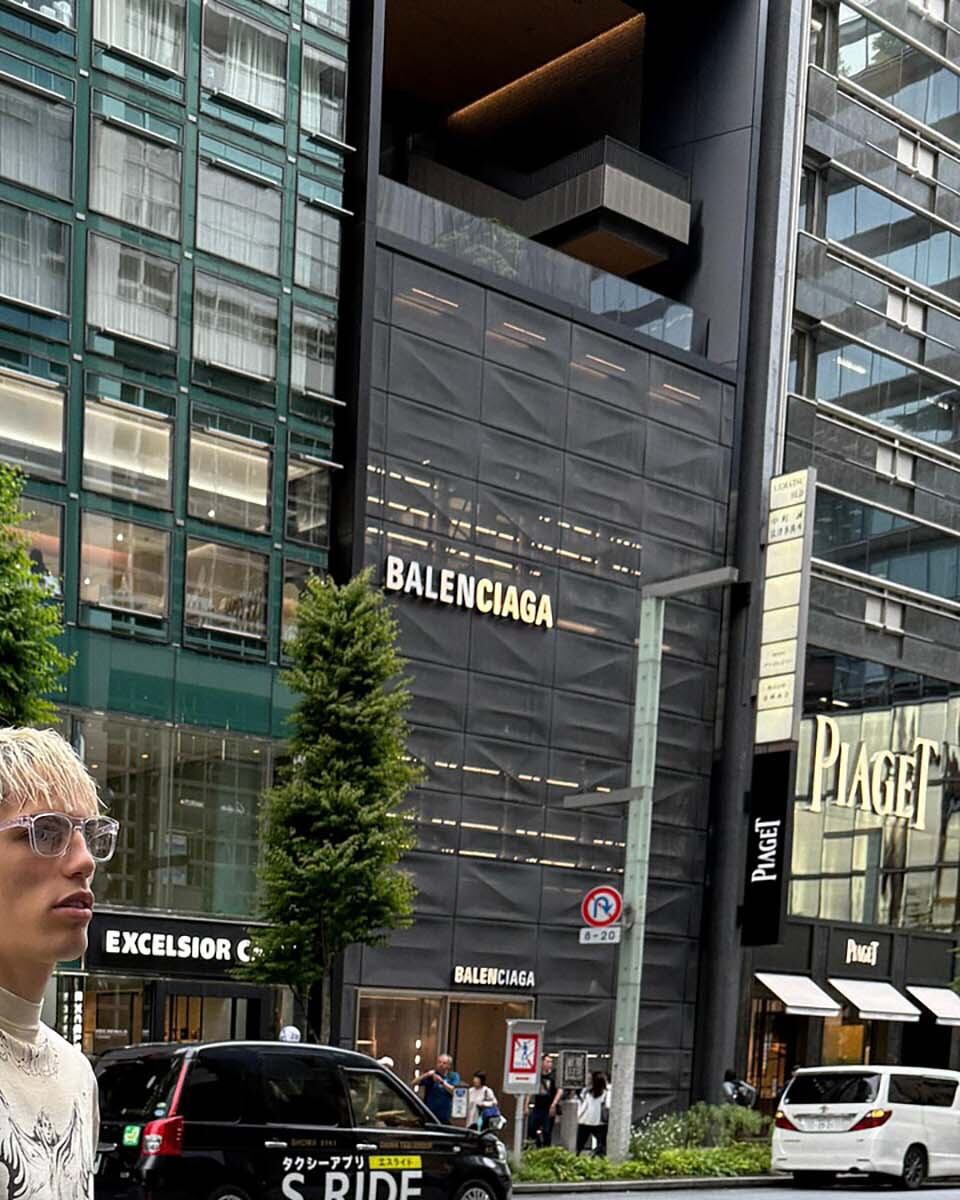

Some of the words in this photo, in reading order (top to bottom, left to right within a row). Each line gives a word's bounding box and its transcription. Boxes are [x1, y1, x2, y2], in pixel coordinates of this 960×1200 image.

[386, 555, 553, 628] BALENCIAGA
[810, 714, 939, 830] PIAGET
[751, 817, 781, 882] PIAGET
[105, 929, 231, 961] EXCELSIOR
[846, 939, 880, 966] PIAGET
[454, 966, 535, 988] BALENCIAGA
[282, 1156, 365, 1171] タクシーアプリ
